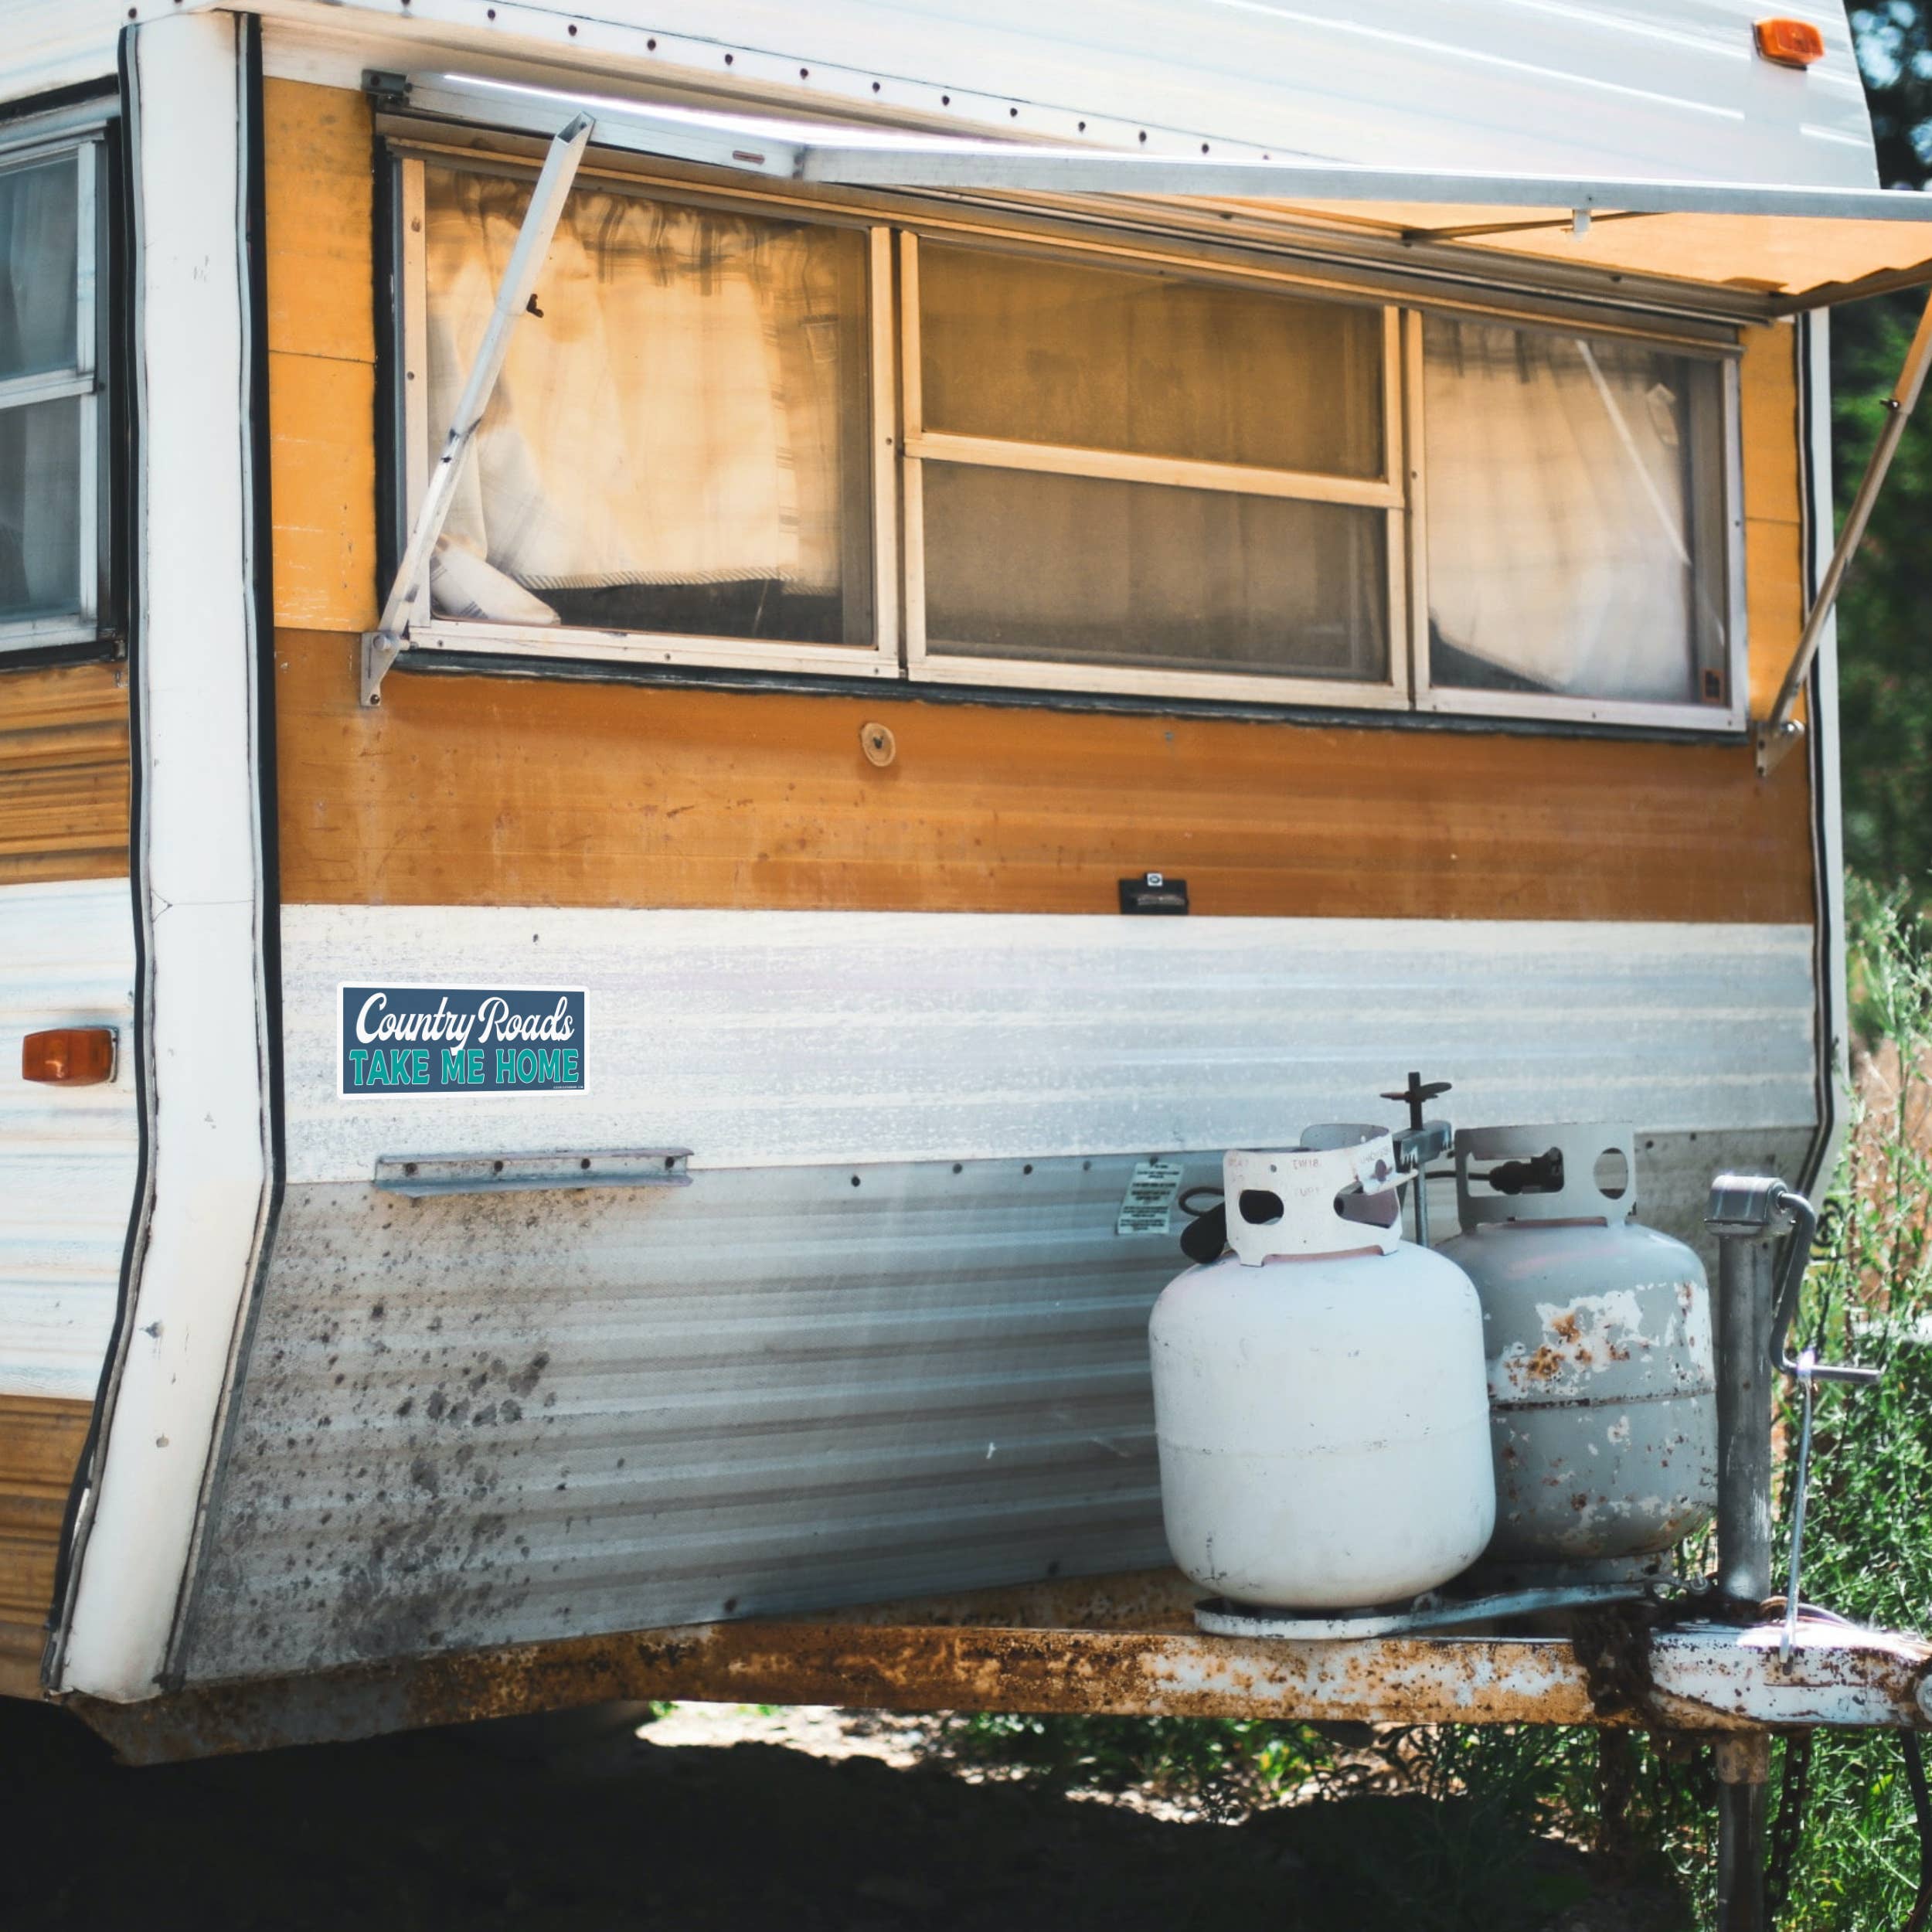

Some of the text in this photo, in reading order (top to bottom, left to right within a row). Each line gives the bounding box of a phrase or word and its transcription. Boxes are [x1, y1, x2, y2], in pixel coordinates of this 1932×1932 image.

[355, 992, 575, 1056] Country Roads
[349, 1048, 579, 1086] TAKE ME HOME
